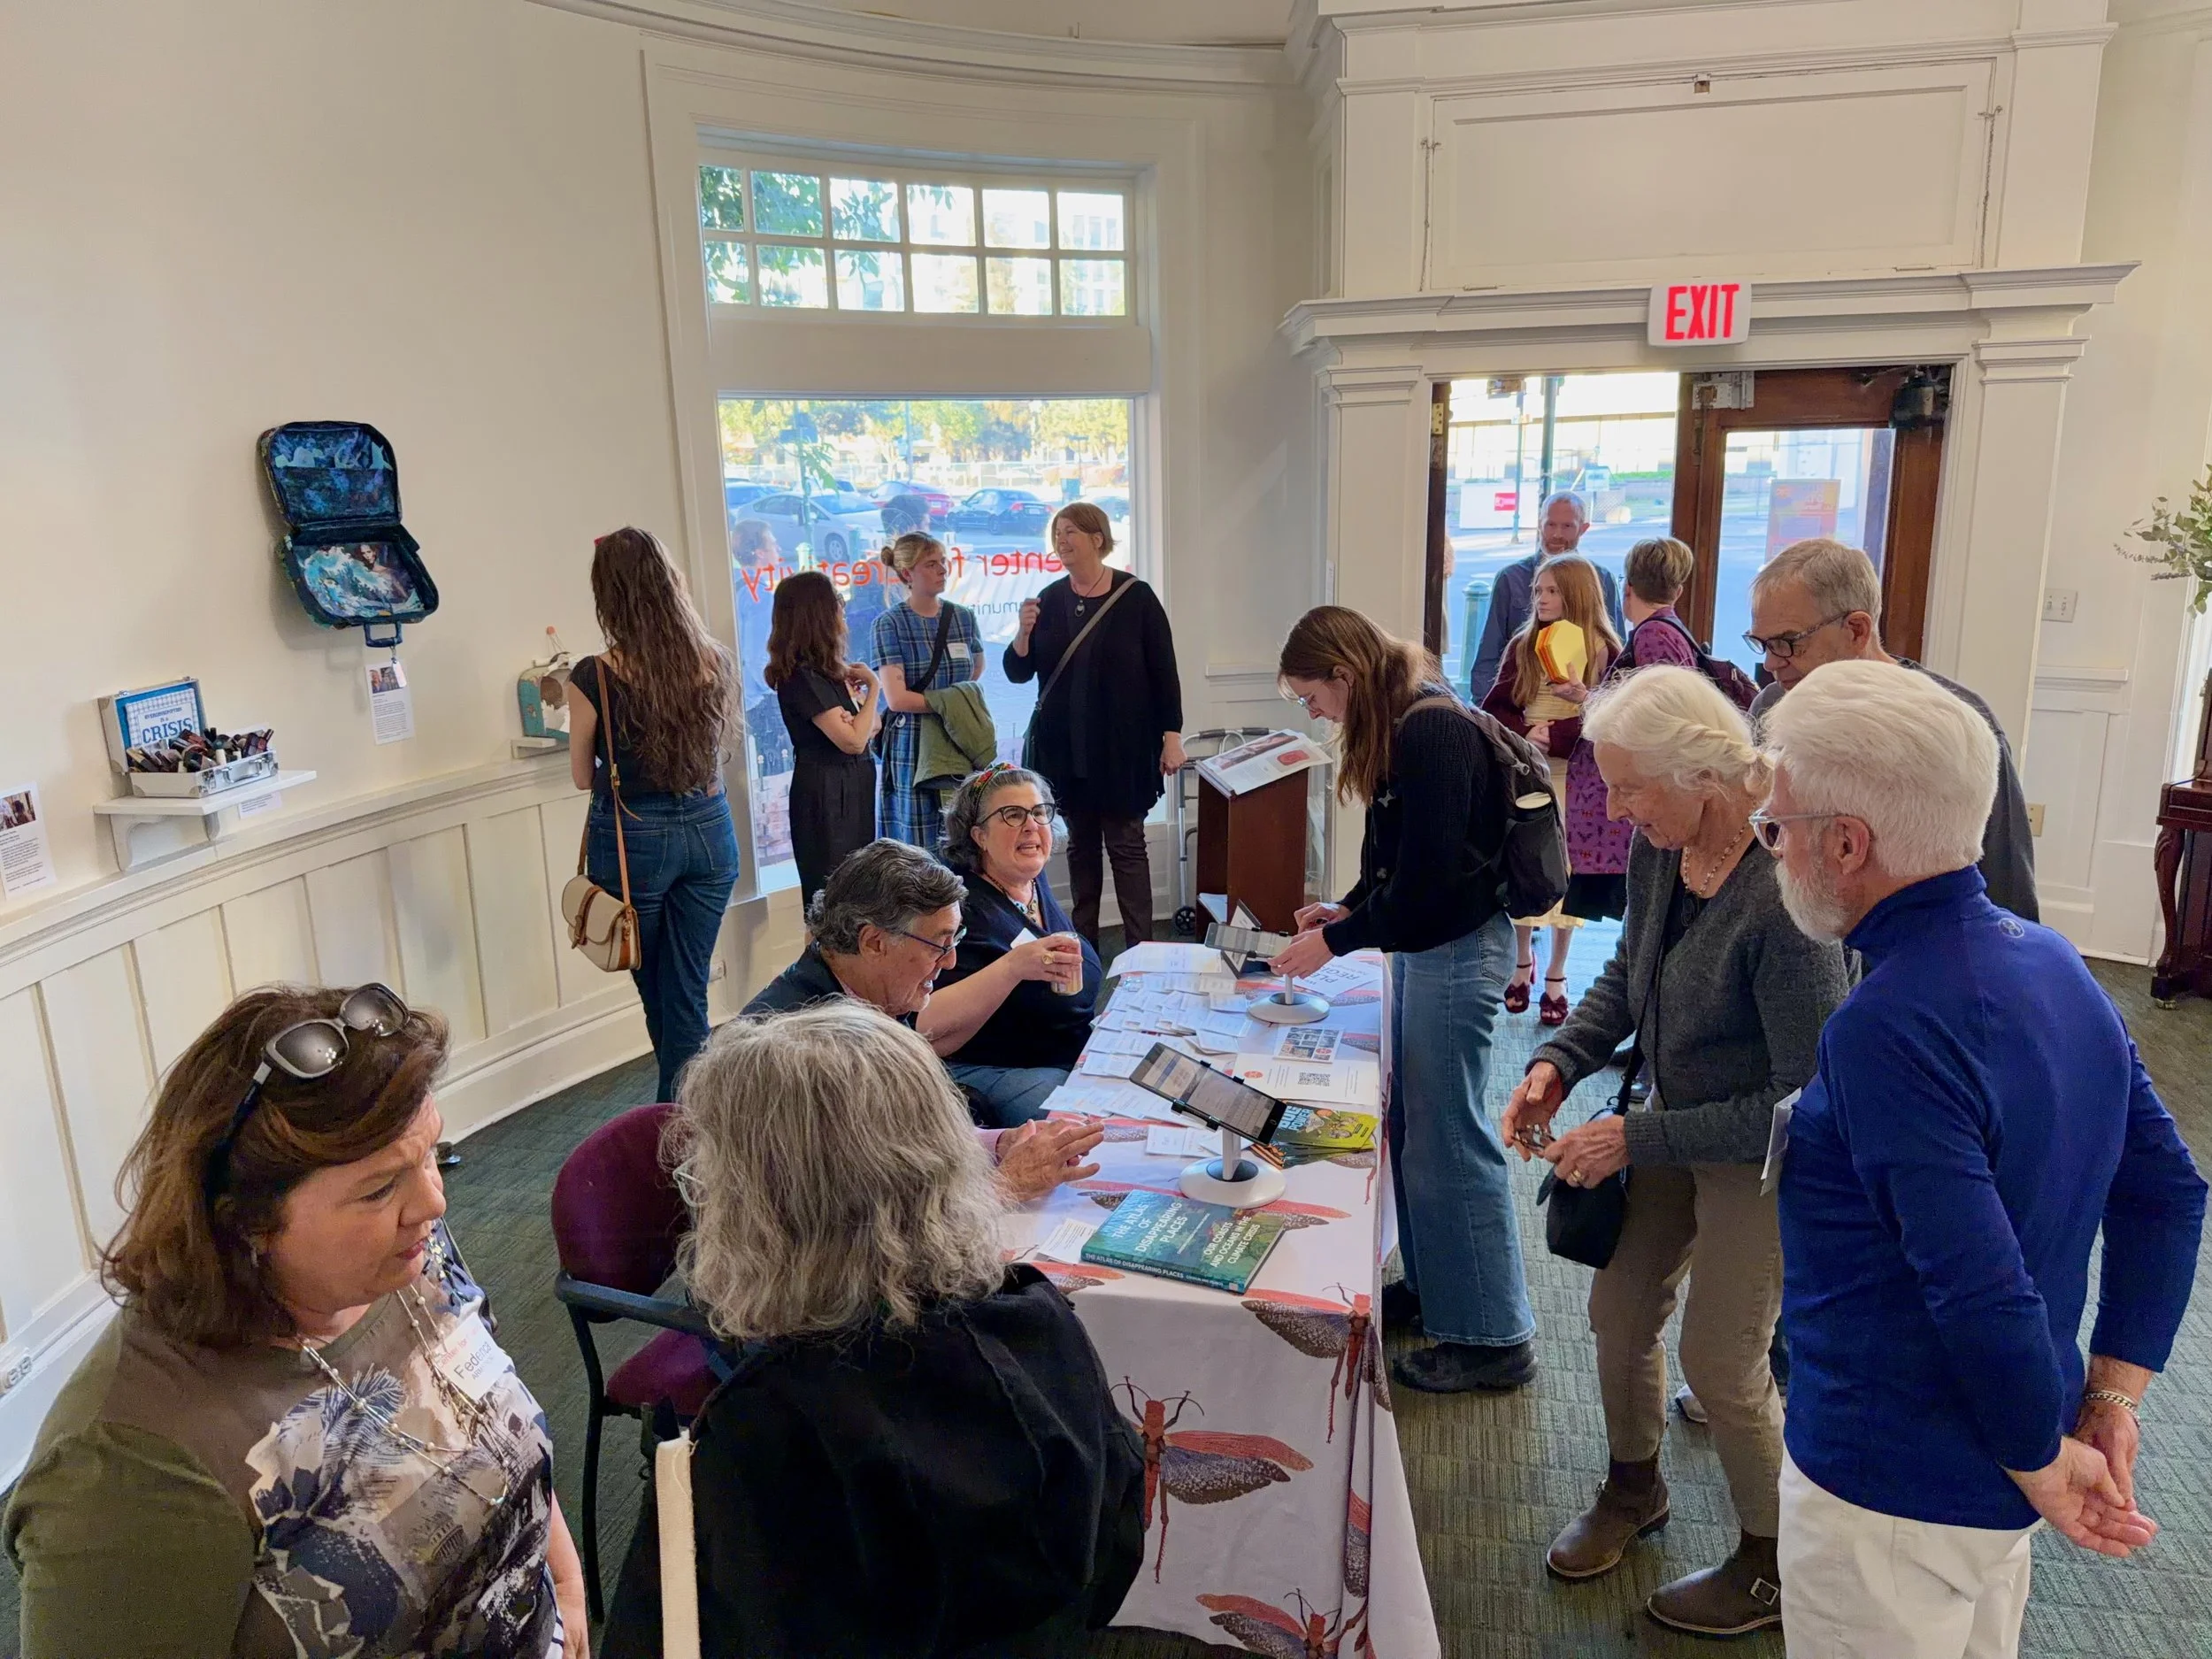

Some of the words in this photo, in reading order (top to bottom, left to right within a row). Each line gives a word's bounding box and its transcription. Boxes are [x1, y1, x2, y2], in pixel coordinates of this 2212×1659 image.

[1665, 283, 1740, 340] EXIT
[142, 718, 193, 744] CRISIS
[1288, 1108, 1312, 1132] POWER
[1111, 1225, 1132, 1239] THE
[1127, 1203, 1149, 1225] ATLAS
[1135, 1202, 1182, 1253] DISAPPEARING
[1138, 1217, 1151, 1229] OF
[1159, 1216, 1188, 1243] PLACES
[1203, 1240, 1219, 1256] OUR
[1213, 1221, 1233, 1243] COASTS
[1210, 1254, 1225, 1268] AND
[1219, 1230, 1240, 1255] OCEANS
[1240, 1215, 1252, 1228] THE
[1227, 1240, 1248, 1264] CLIMATE
[1244, 1224, 1261, 1242] CRISIS
[1096, 1255, 1113, 1264] ATLAS
[1122, 1261, 1162, 1275] DISAPPEARING
[1163, 1269, 1184, 1279] PLACES
